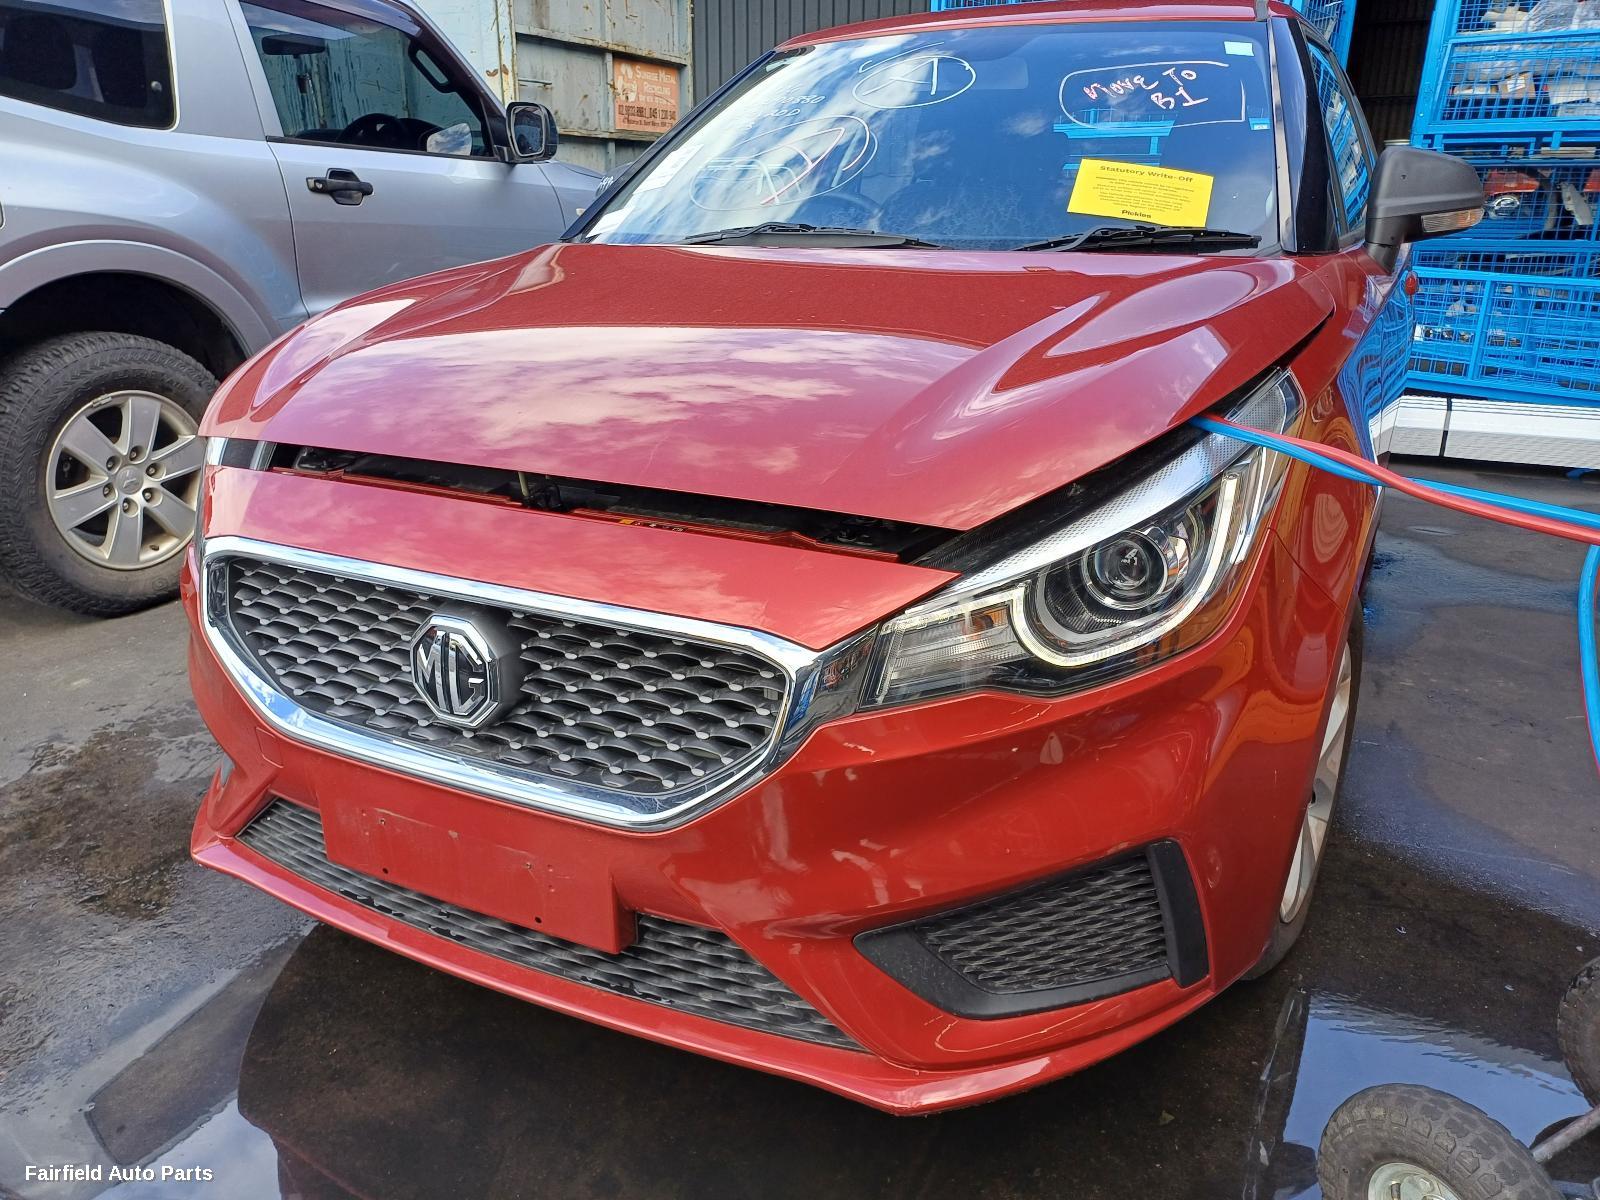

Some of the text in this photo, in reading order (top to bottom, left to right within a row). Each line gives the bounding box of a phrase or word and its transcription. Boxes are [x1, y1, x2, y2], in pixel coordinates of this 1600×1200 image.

[1100, 165, 1194, 183] Statutory Write-Off
[1121, 209, 1152, 219] Pickles
[416, 629, 486, 716] MG
